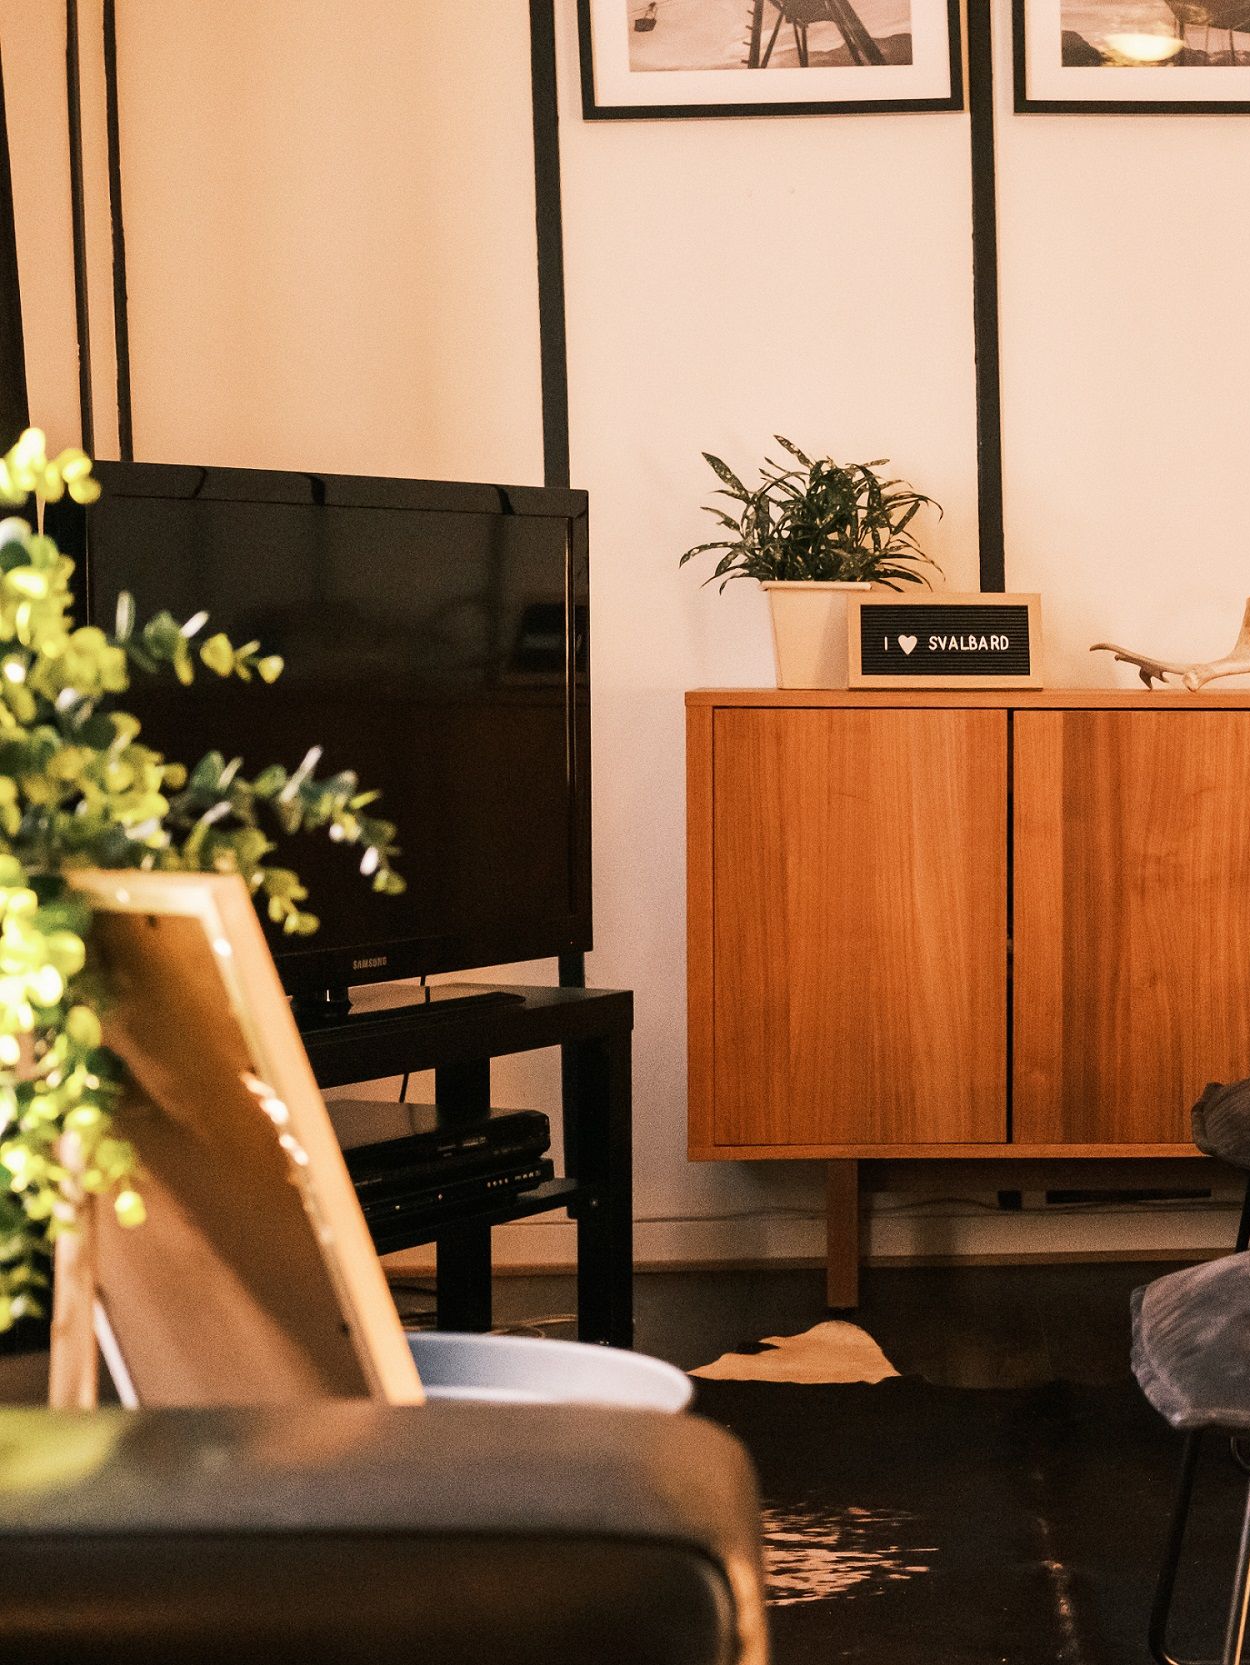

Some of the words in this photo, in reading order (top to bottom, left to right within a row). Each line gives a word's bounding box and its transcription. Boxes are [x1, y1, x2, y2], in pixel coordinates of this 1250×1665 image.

[884, 636, 888, 651] I
[928, 635, 1009, 651] SVALBARD
[352, 956, 388, 970] SAMSUNG
